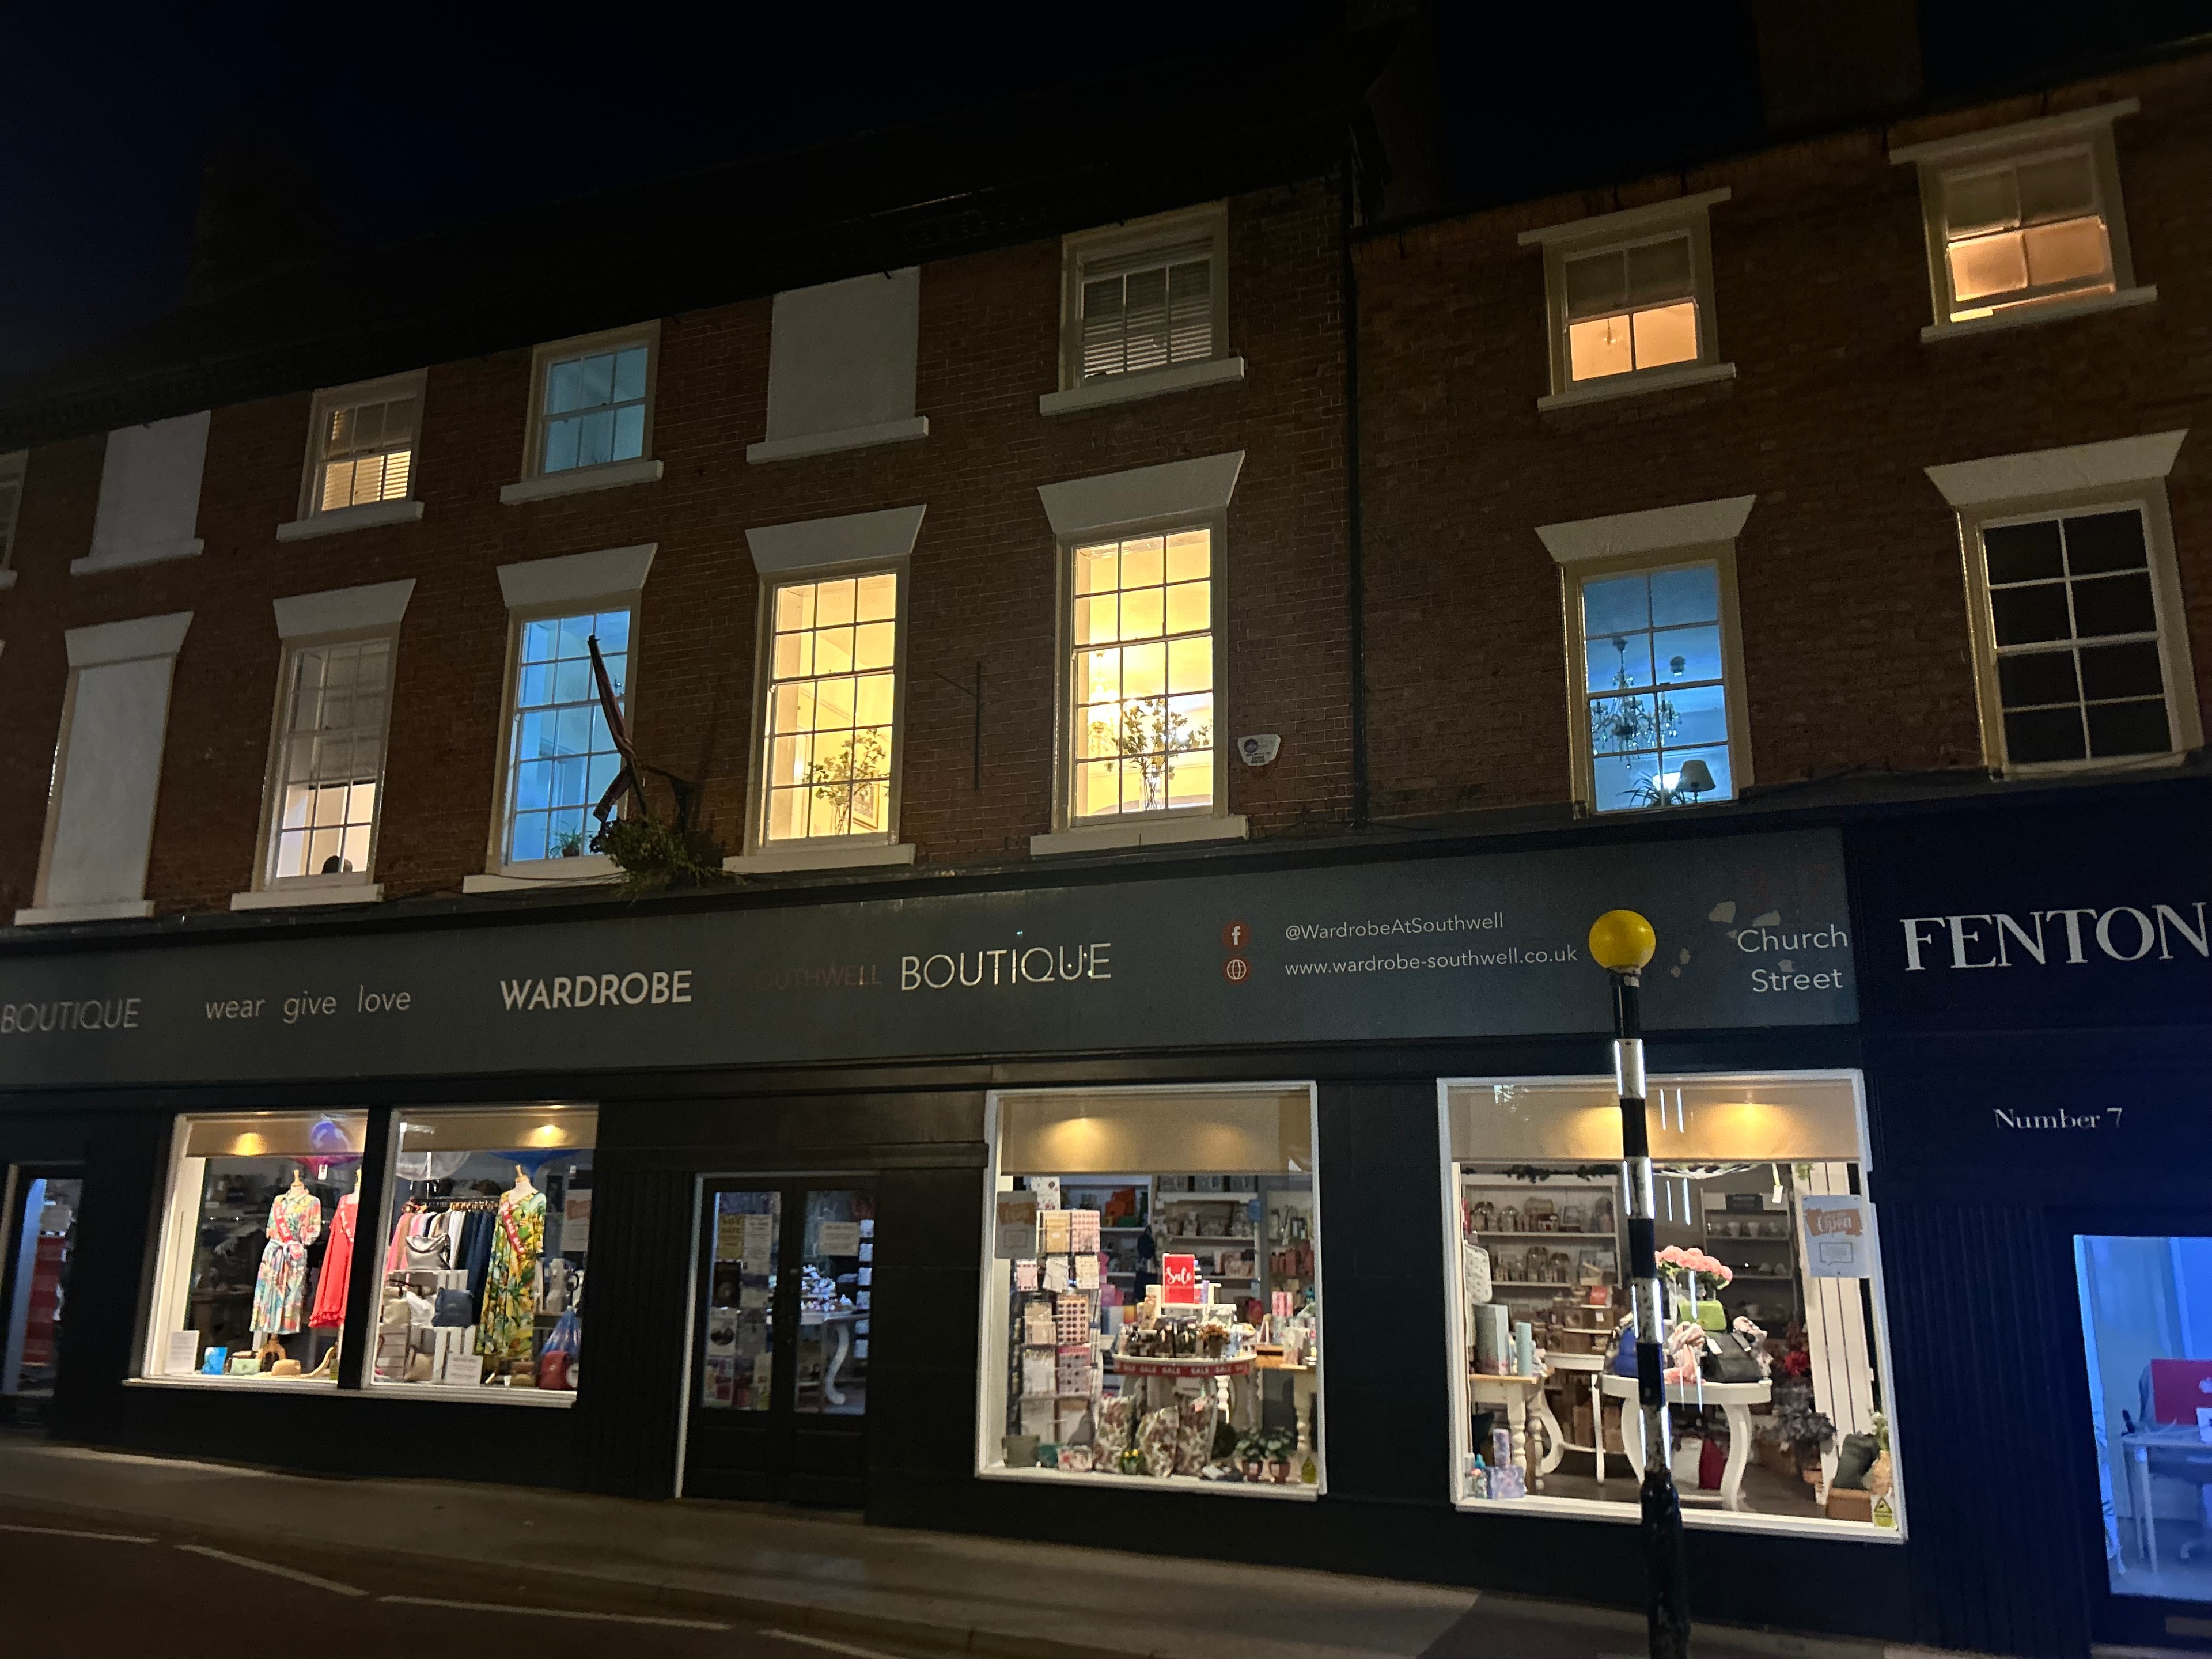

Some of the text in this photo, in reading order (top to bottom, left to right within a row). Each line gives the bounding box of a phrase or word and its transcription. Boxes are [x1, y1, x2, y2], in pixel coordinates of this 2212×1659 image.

[1285, 912, 1504, 941] @WardrobeAtSouthwell
[1737, 923, 1848, 952] Church
[1900, 902, 2210, 971] FENTON
[900, 942, 1111, 991] BOUTIQUE
[1285, 945, 1578, 976] www.wardrobe-southwell.co.uk
[500, 970, 692, 1011] WARDROBE
[1751, 969, 1843, 992] Street
[1, 997, 142, 1035] BOUTIQUE
[206, 984, 412, 1024] wear give love
[1993, 1107, 2123, 1129] Number 7
[1165, 1266, 1193, 1285] Sale
[1162, 1365, 1180, 1373] SALE
[1190, 1365, 1209, 1373] SALE
